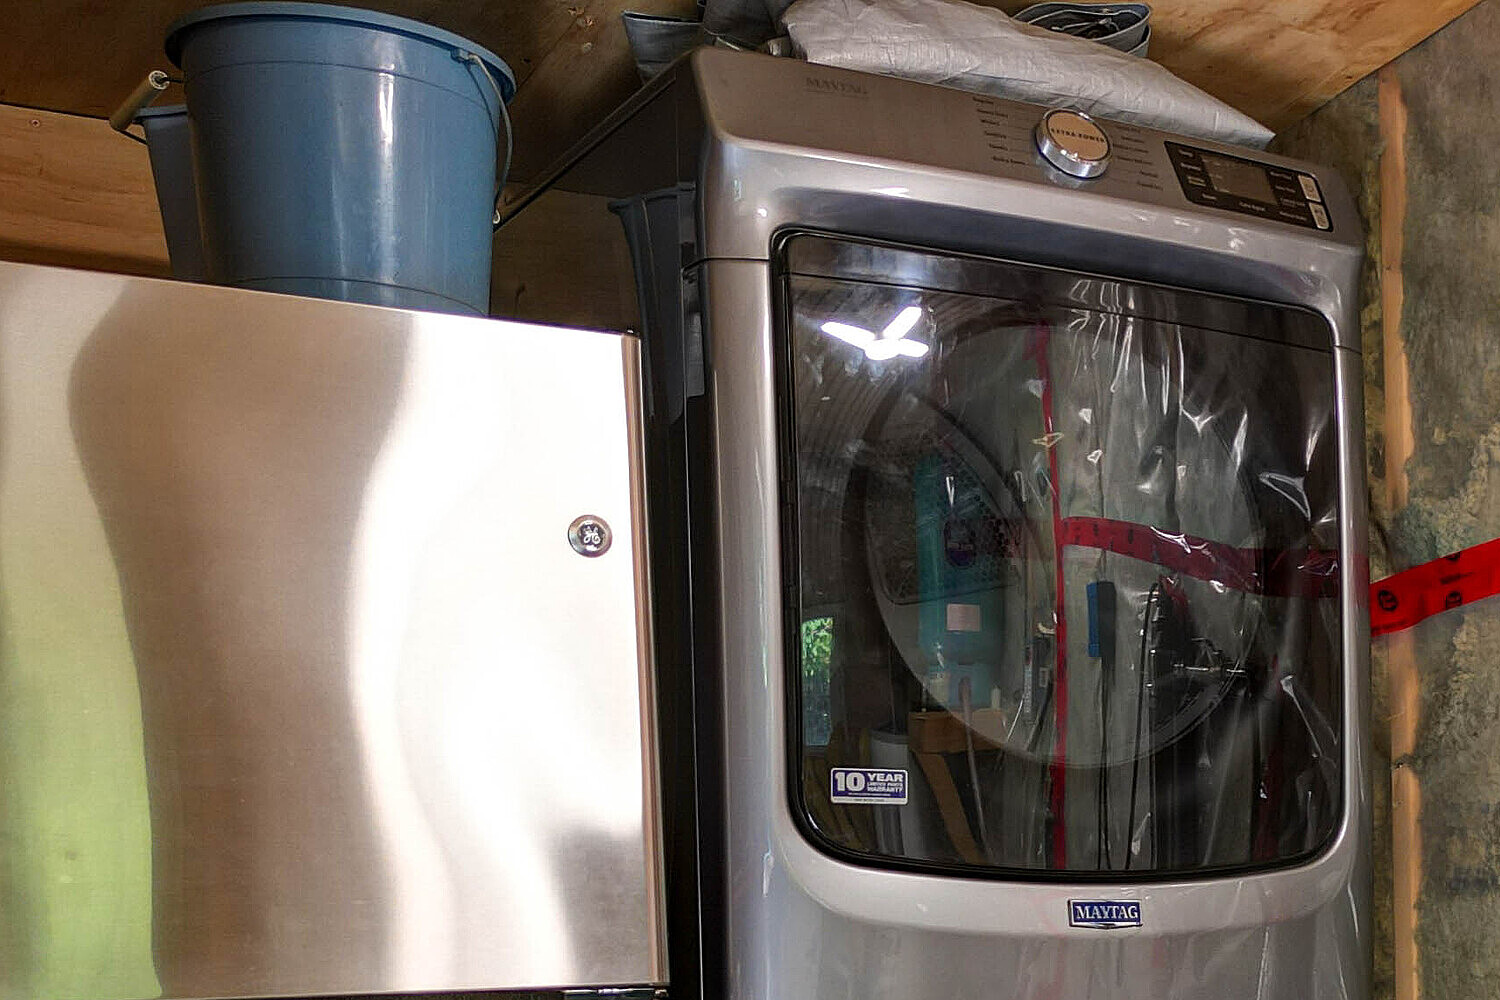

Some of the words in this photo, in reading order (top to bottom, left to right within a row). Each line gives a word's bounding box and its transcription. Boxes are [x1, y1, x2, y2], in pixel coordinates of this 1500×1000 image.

[835, 772, 865, 791] 10
[868, 773, 903, 782] YEAR
[1074, 905, 1139, 919] MAYTAG
